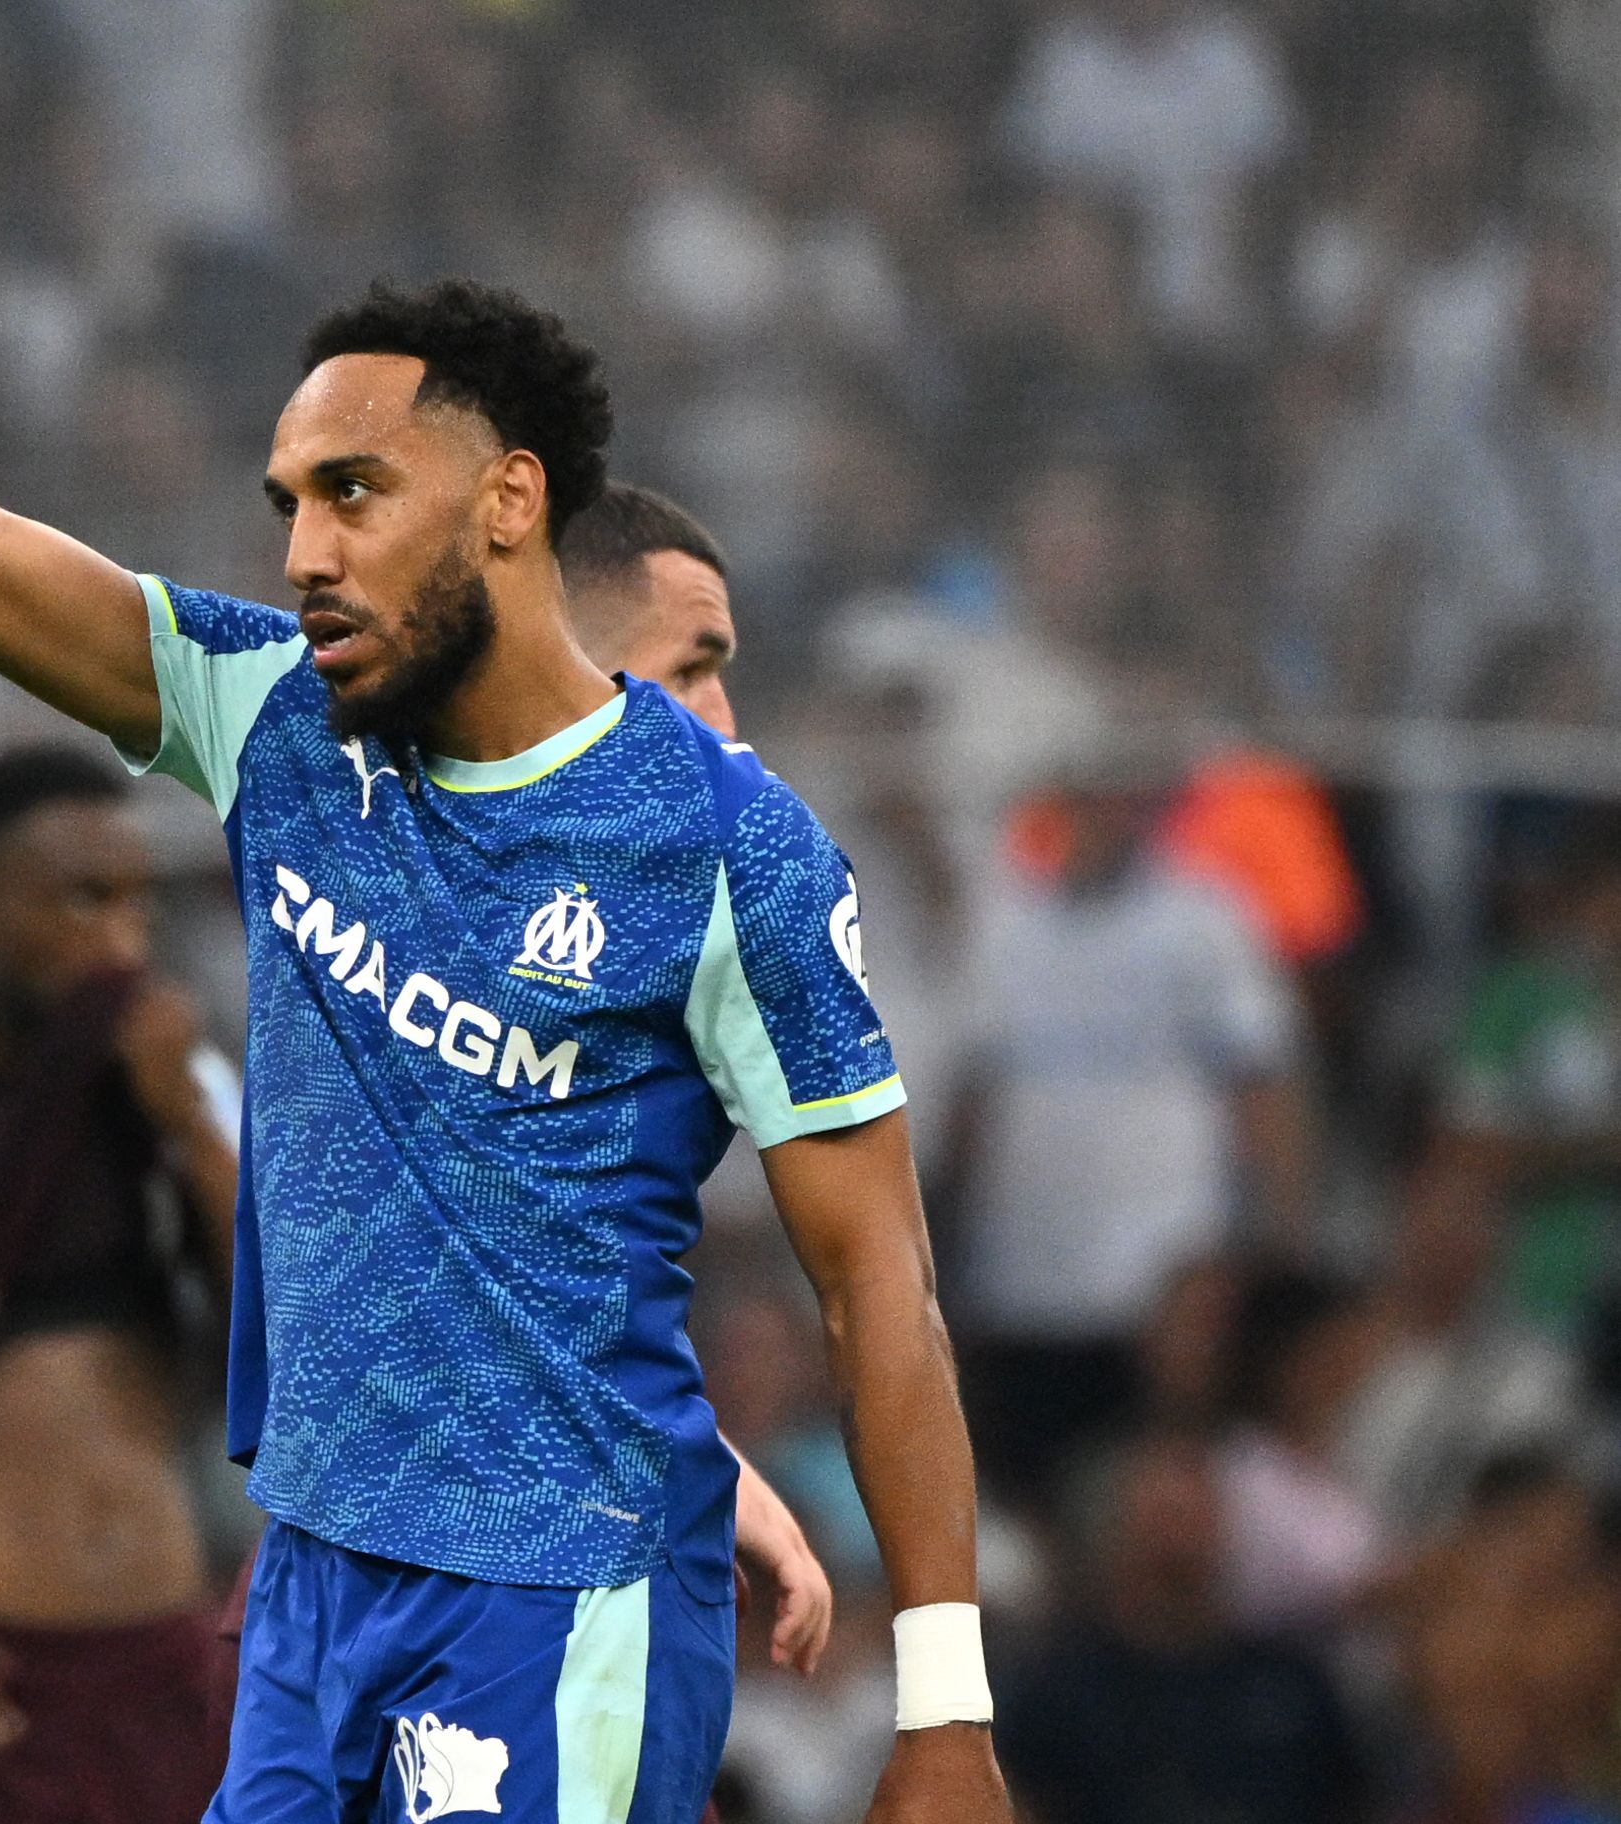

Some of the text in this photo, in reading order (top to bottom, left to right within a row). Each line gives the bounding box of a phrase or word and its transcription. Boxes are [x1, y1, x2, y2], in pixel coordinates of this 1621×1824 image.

[508, 966, 591, 991] DROIT AU BUT
